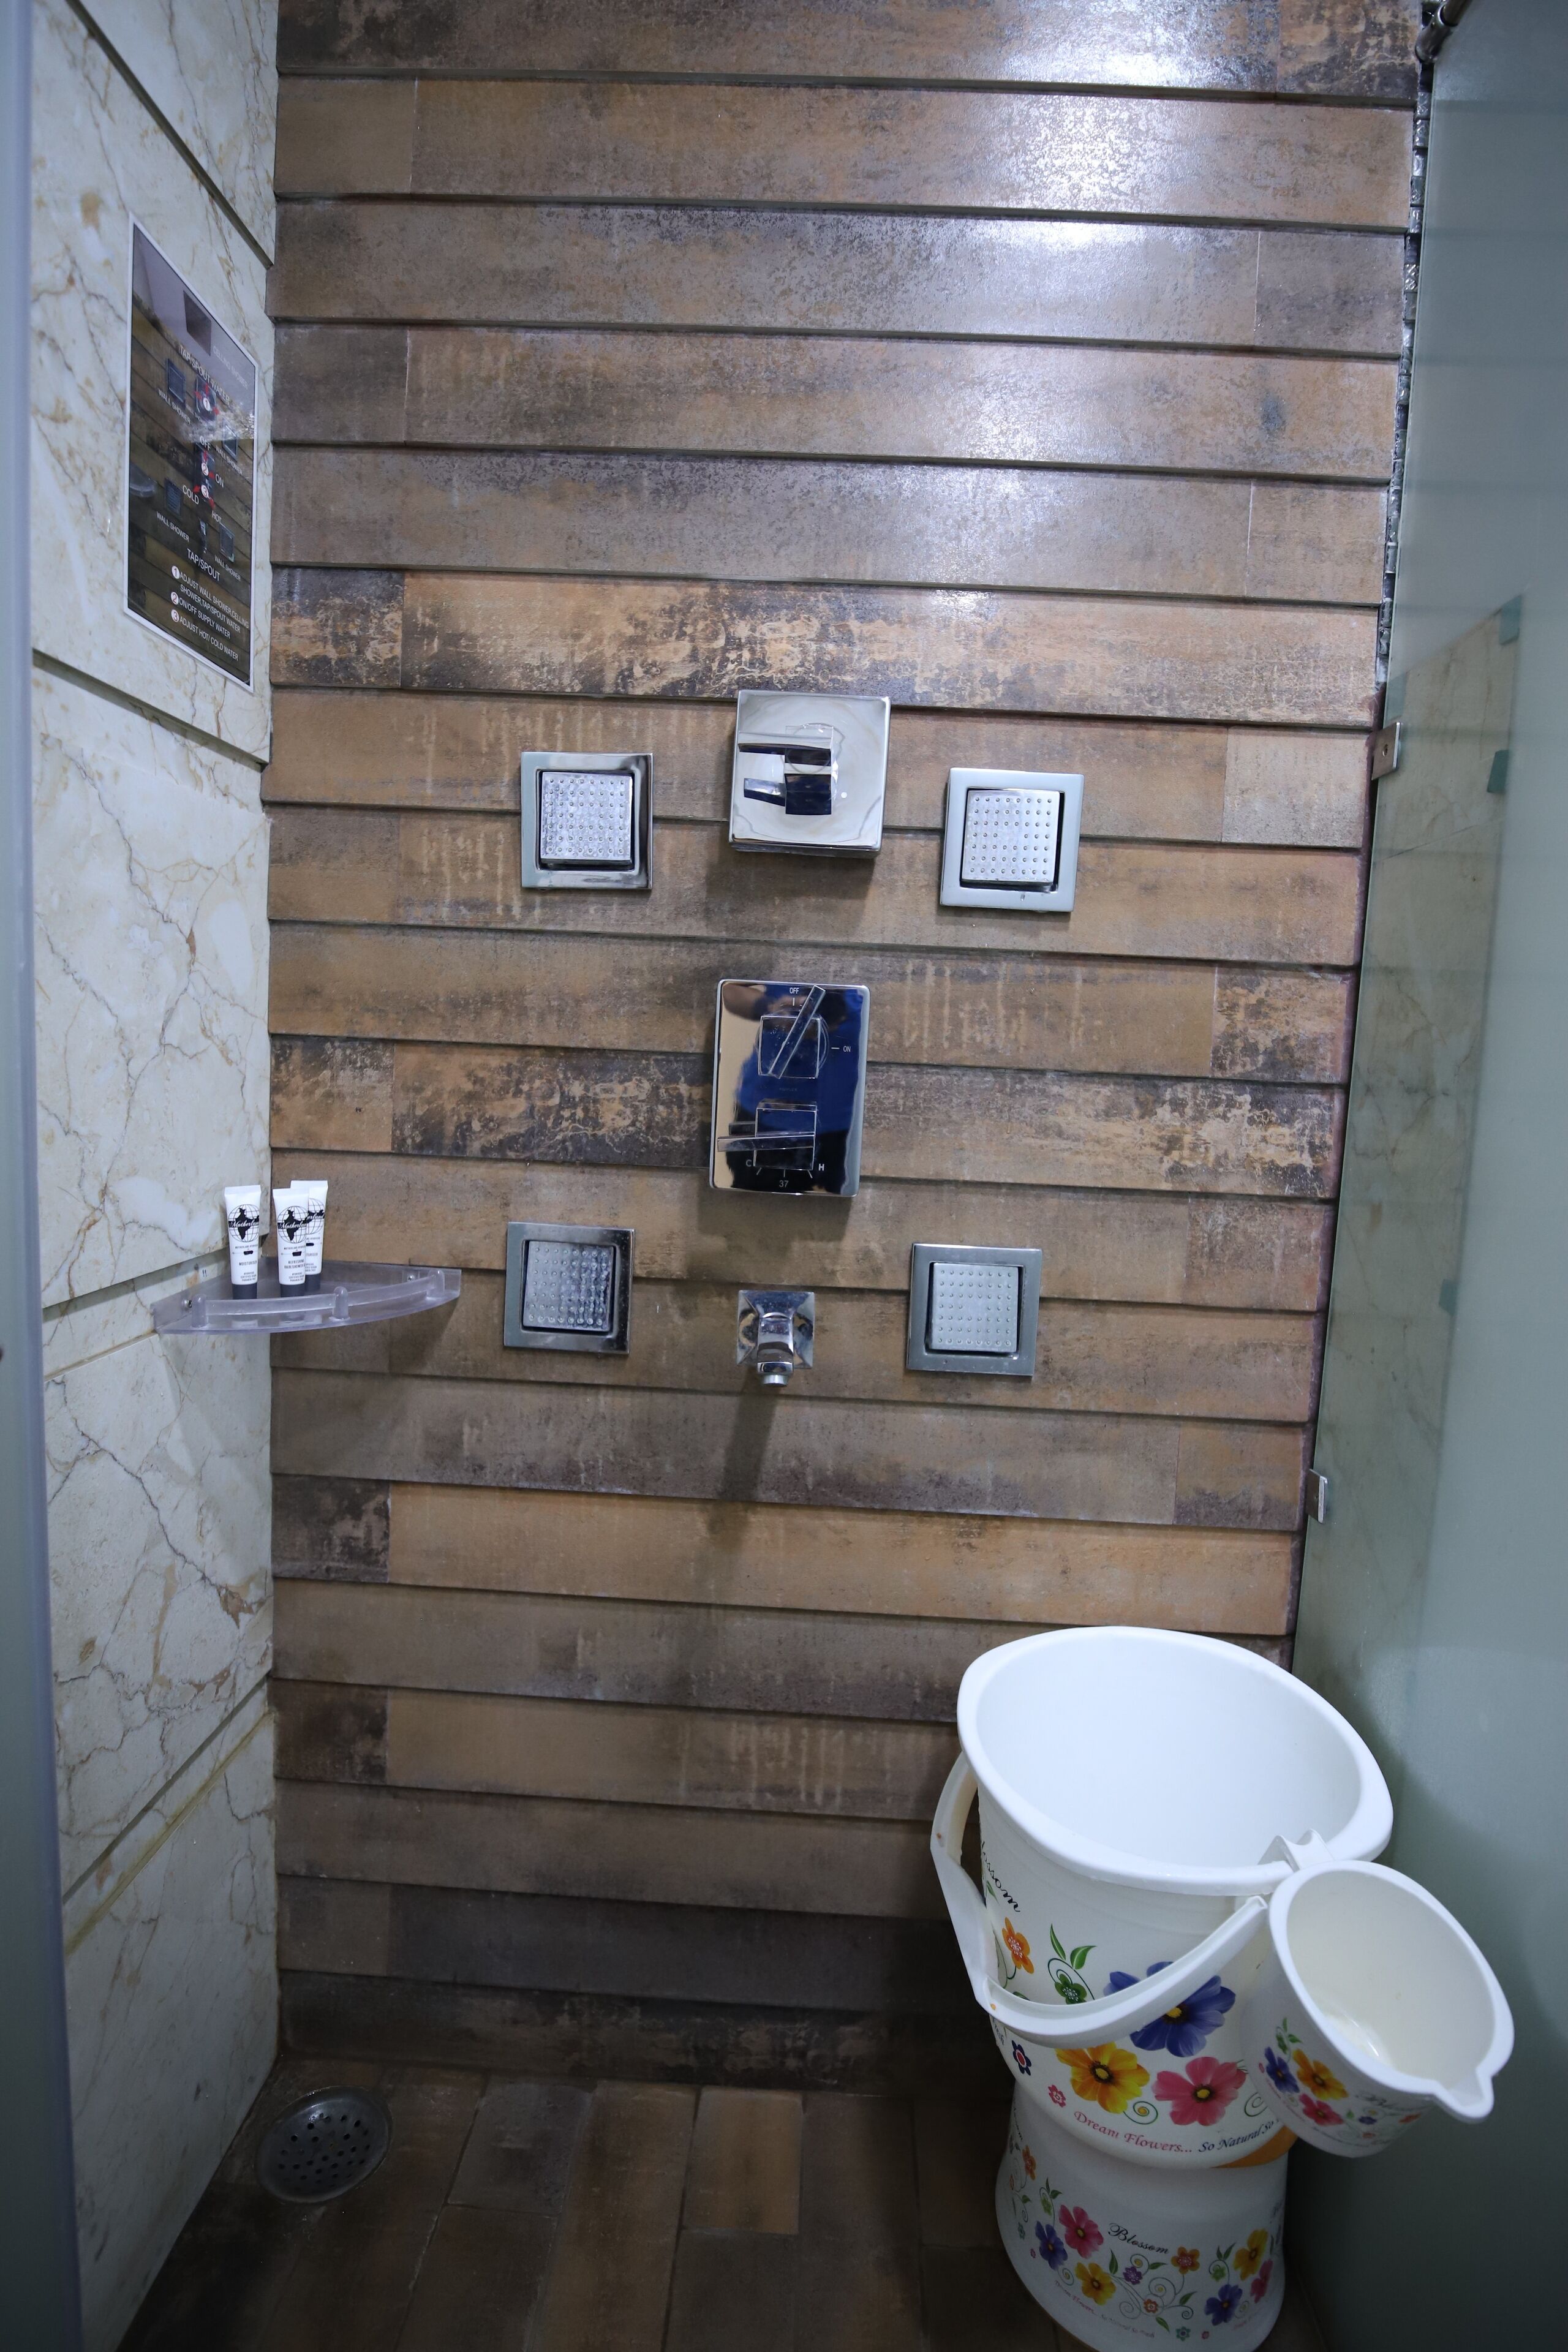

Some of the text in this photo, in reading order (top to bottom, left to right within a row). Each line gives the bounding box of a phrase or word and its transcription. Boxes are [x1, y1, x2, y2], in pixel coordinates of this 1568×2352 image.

[158, 388, 190, 424] WALL SHOWER
[200, 435, 211, 450] OFF
[216, 445, 243, 476] WALL SHOWER
[183, 484, 199, 505] COLD
[216, 473, 224, 488] ON
[156, 511, 189, 542] WALL SHOWER
[212, 510, 222, 524] HOT
[187, 548, 221, 581] TAP/SPOUT
[214, 555, 241, 582] WALL SHOWER
[179, 571, 199, 590] ADJUST
[199, 586, 212, 601] WALL
[179, 597, 197, 615] ON/OFF
[198, 610, 215, 628] SUPPLY
[216, 622, 231, 639] WATER
[226, 617, 241, 633] WATER
[179, 616, 198, 634] ADJUST
[210, 637, 224, 650] COLD
[224, 646, 238, 661] WATER
[745, 1159, 752, 1167] C
[1074, 2111, 1119, 2139] Dream
[1124, 2133, 1193, 2153] Flowers...
[1198, 2141, 1215, 2153] So
[1216, 2124, 1264, 2150] Natural
[1107, 2222, 1169, 2255] Blossom
